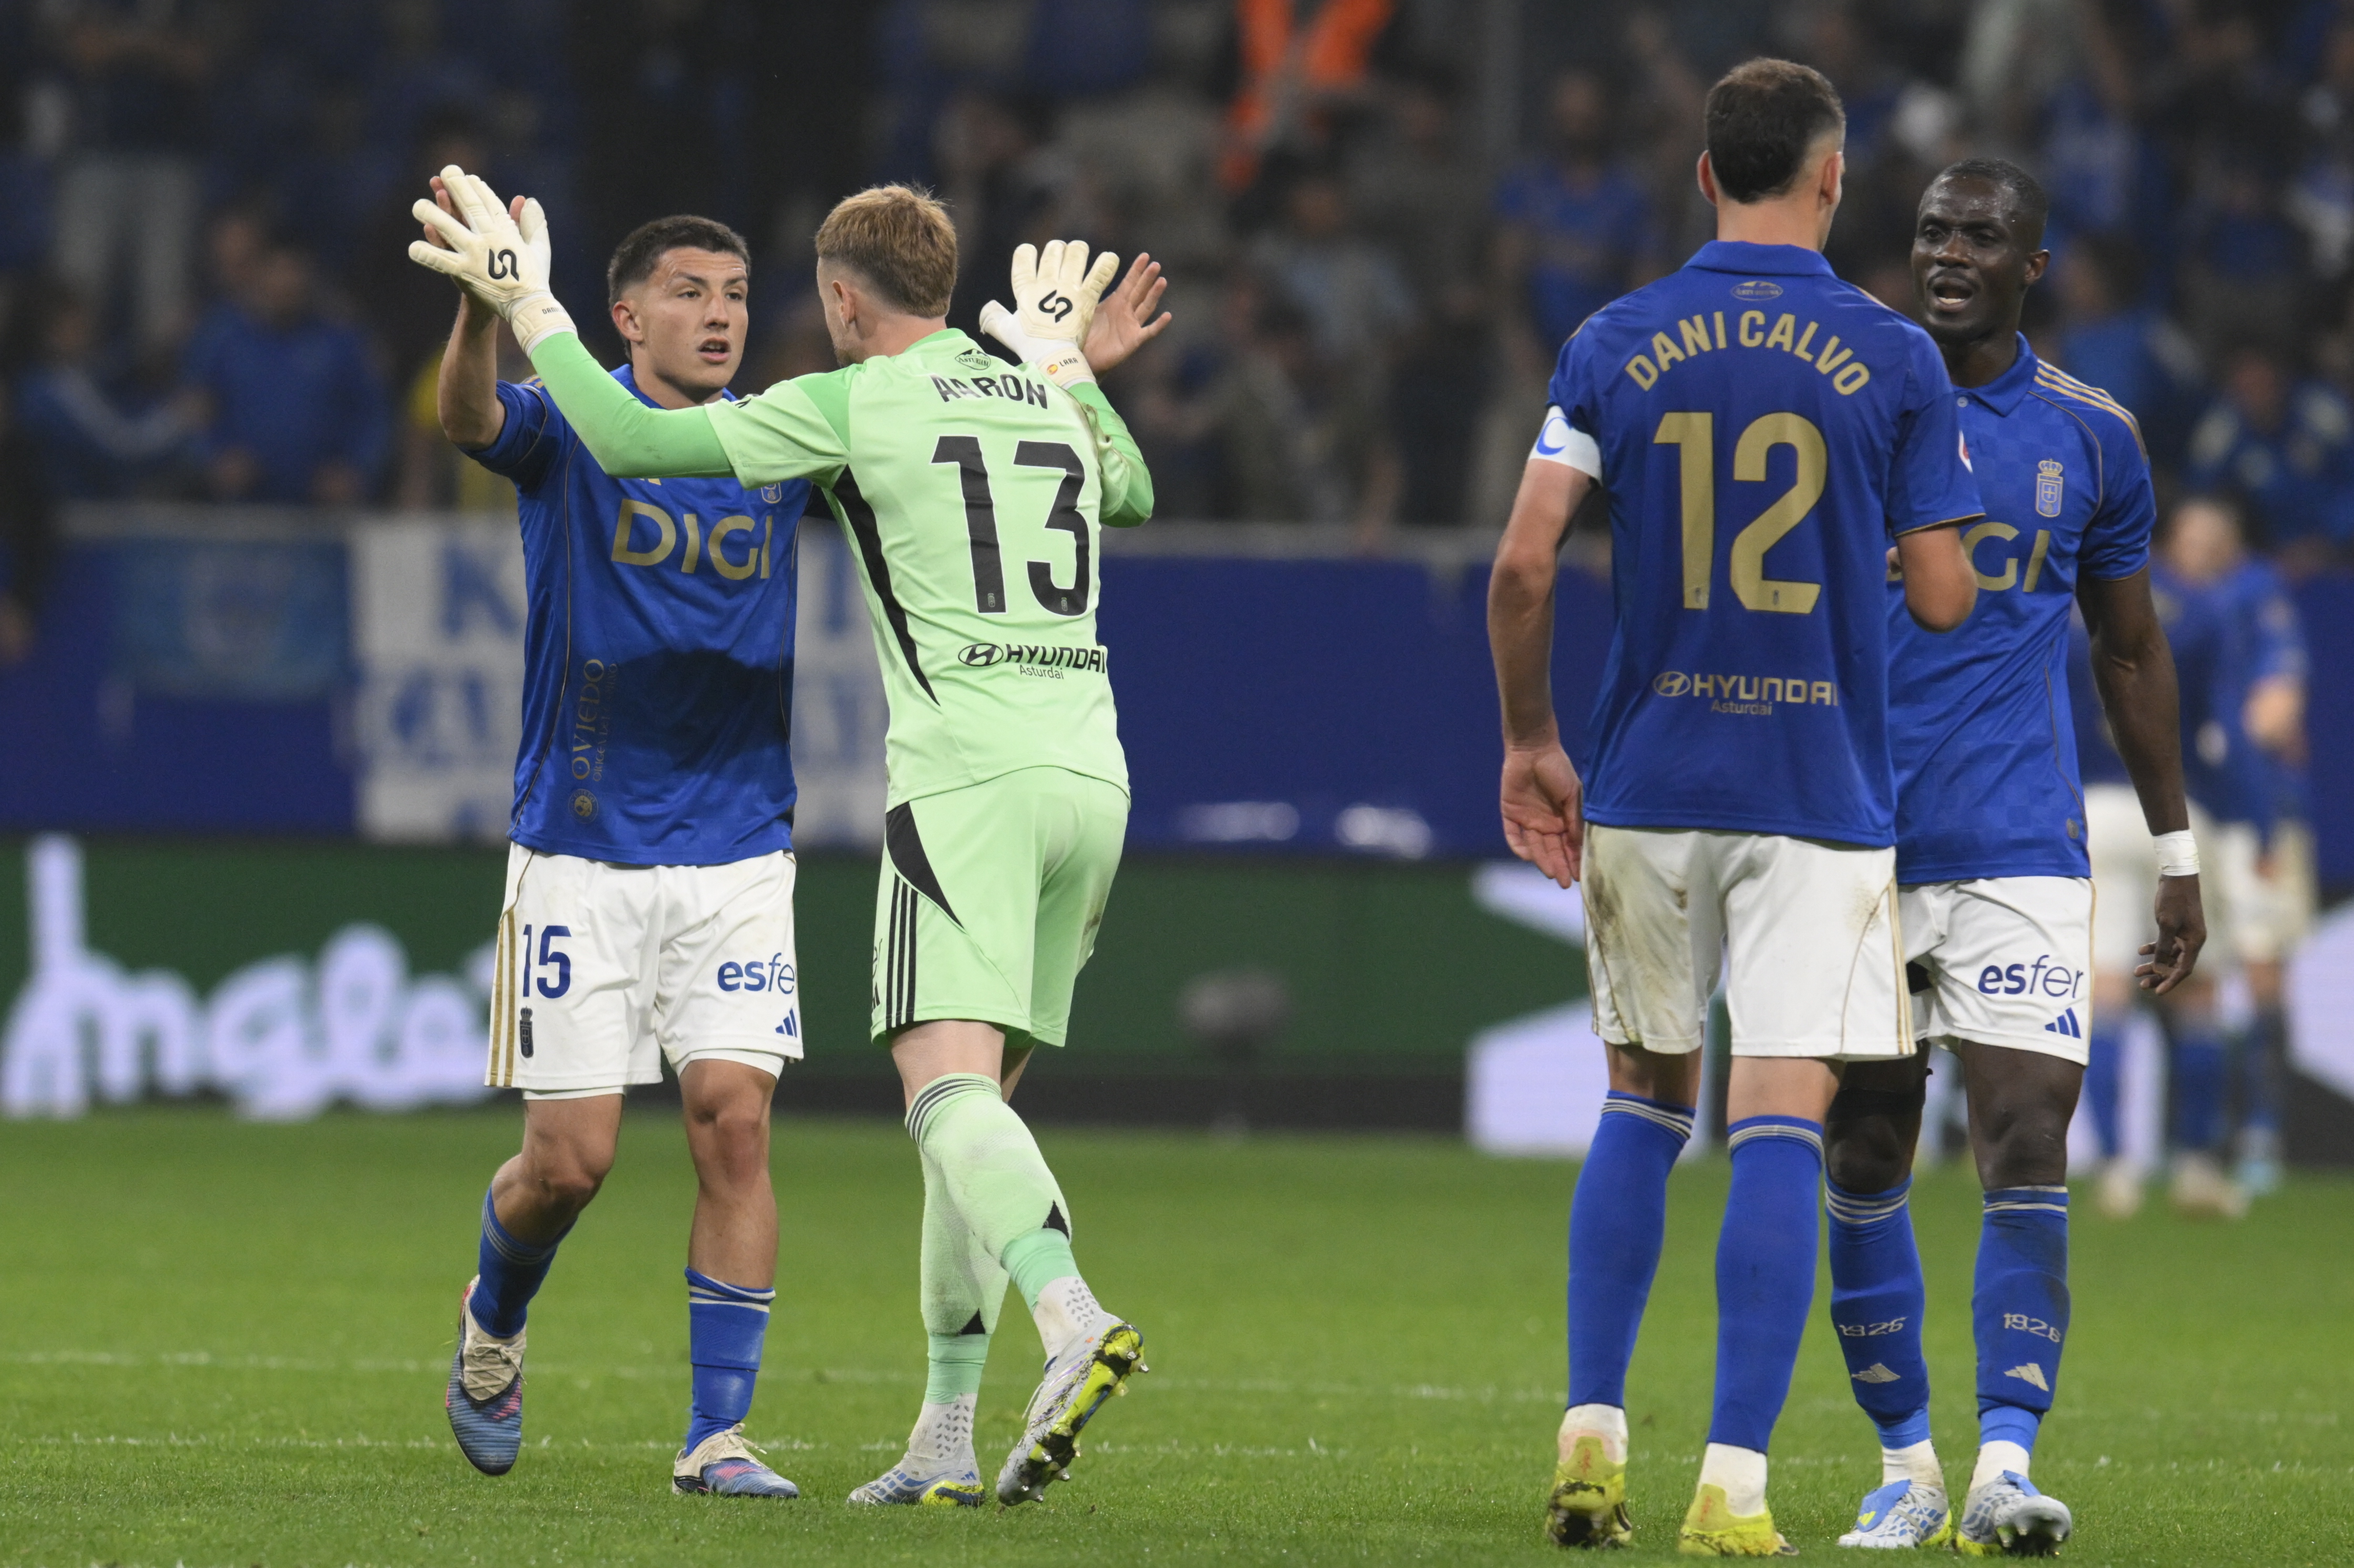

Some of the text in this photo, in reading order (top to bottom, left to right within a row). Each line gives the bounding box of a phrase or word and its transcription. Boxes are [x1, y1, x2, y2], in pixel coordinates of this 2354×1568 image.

[1059, 357, 1079, 367] LARA
[1624, 310, 1871, 396] DANI CALVO
[930, 373, 1048, 410] AARON
[929, 435, 1090, 616] 13
[1653, 411, 1828, 614] 12
[611, 500, 773, 581] DIGI
[1005, 643, 1106, 674] HYUNDAI
[1019, 664, 1065, 679] Asturdai
[1692, 673, 1839, 707] HYUNDAI
[1710, 699, 1773, 716] Asturdai
[572, 658, 605, 780] OVIEDO
[522, 924, 572, 999] 15
[717, 952, 796, 994] esfe
[1978, 954, 2084, 998] esfer
[1839, 1315, 1908, 1337] 1926
[2002, 1313, 2061, 1343] 1926
